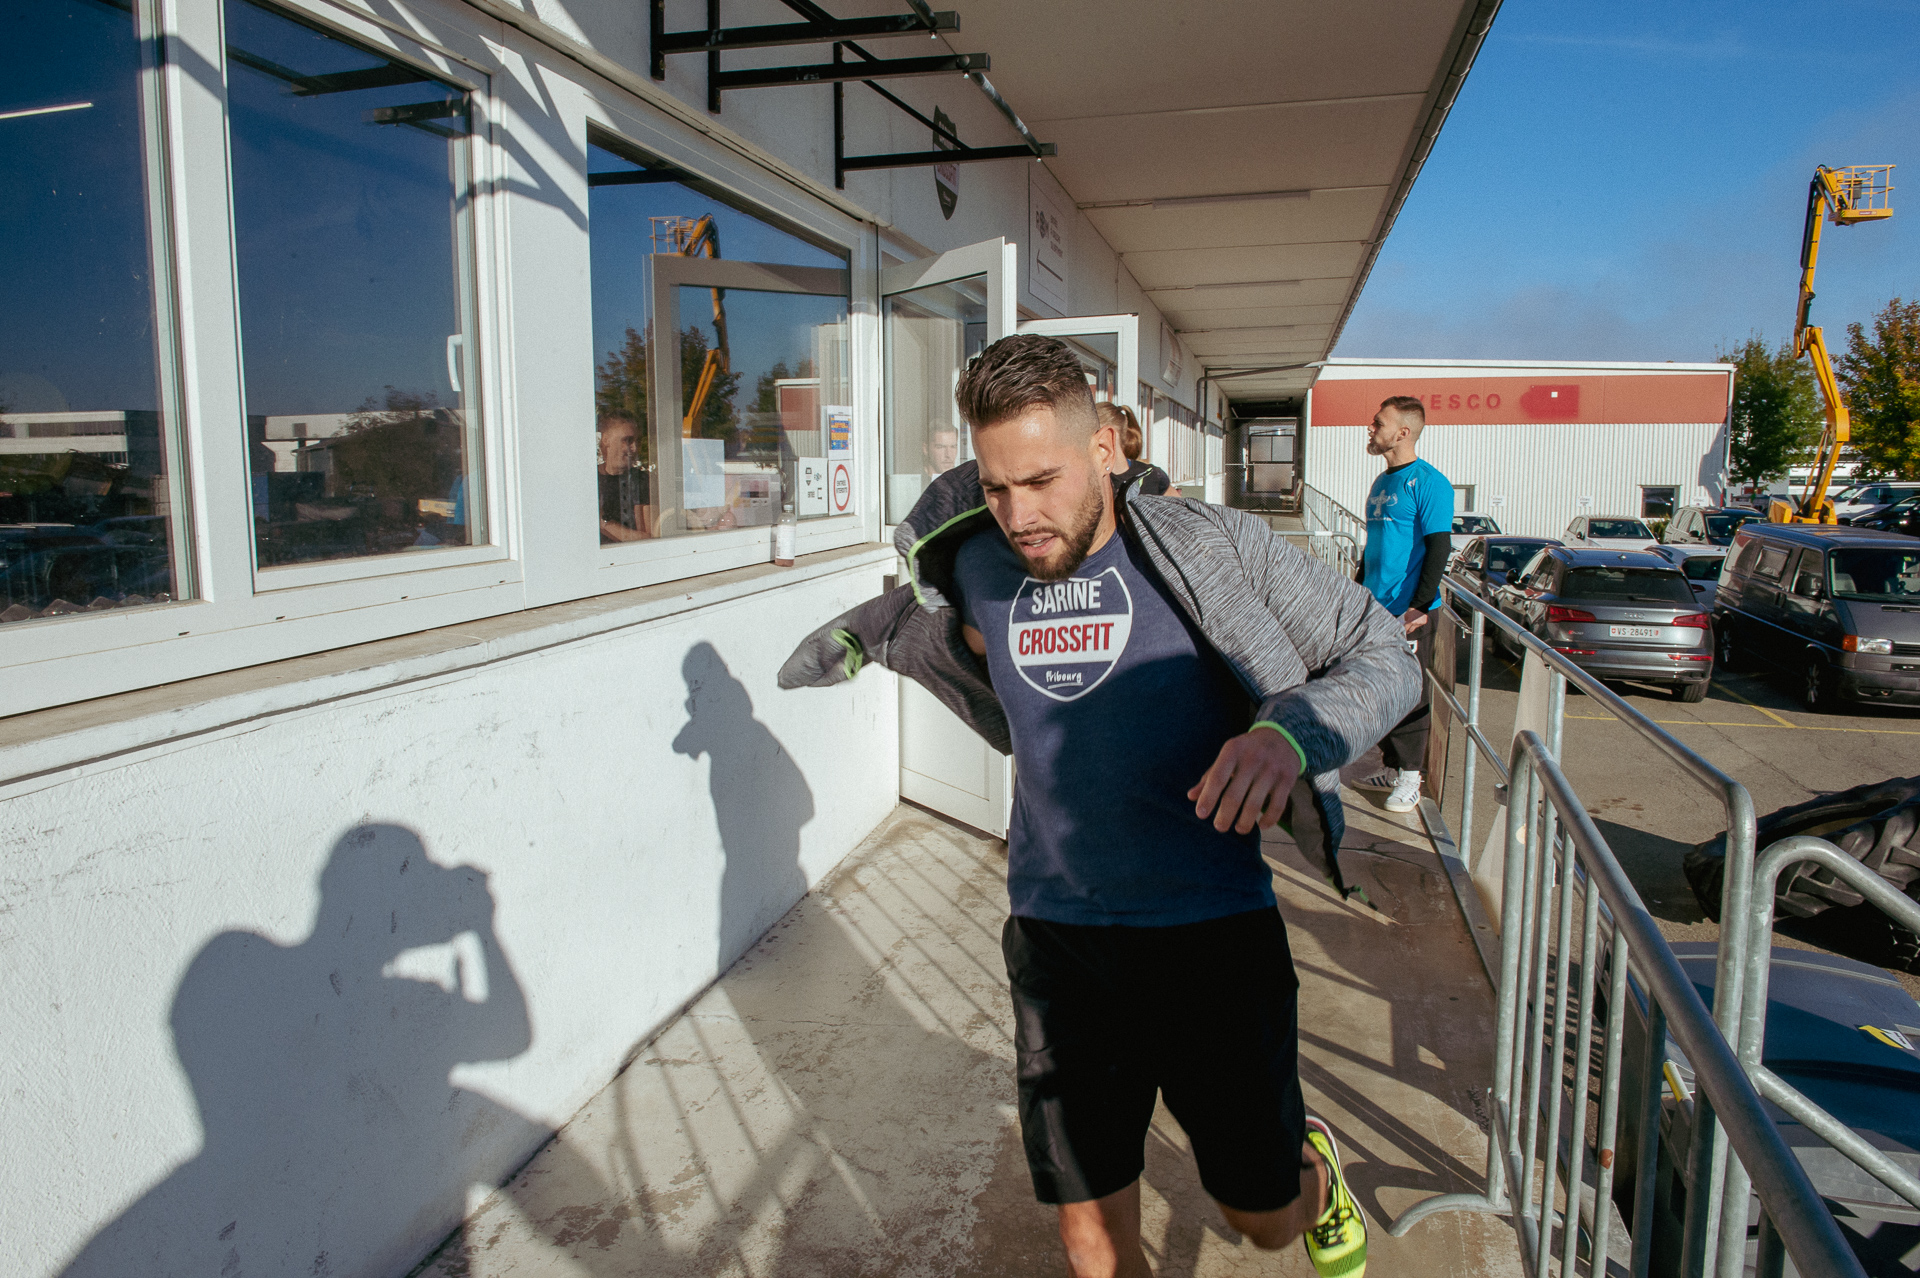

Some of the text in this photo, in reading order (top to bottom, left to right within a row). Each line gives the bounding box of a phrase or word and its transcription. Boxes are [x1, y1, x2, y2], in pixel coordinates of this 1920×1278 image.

[1397, 393, 1501, 410] ESCO
[1031, 580, 1102, 615] SARINE
[1018, 622, 1115, 656] CROSSFIT
[1045, 671, 1082, 684] Fribourg
